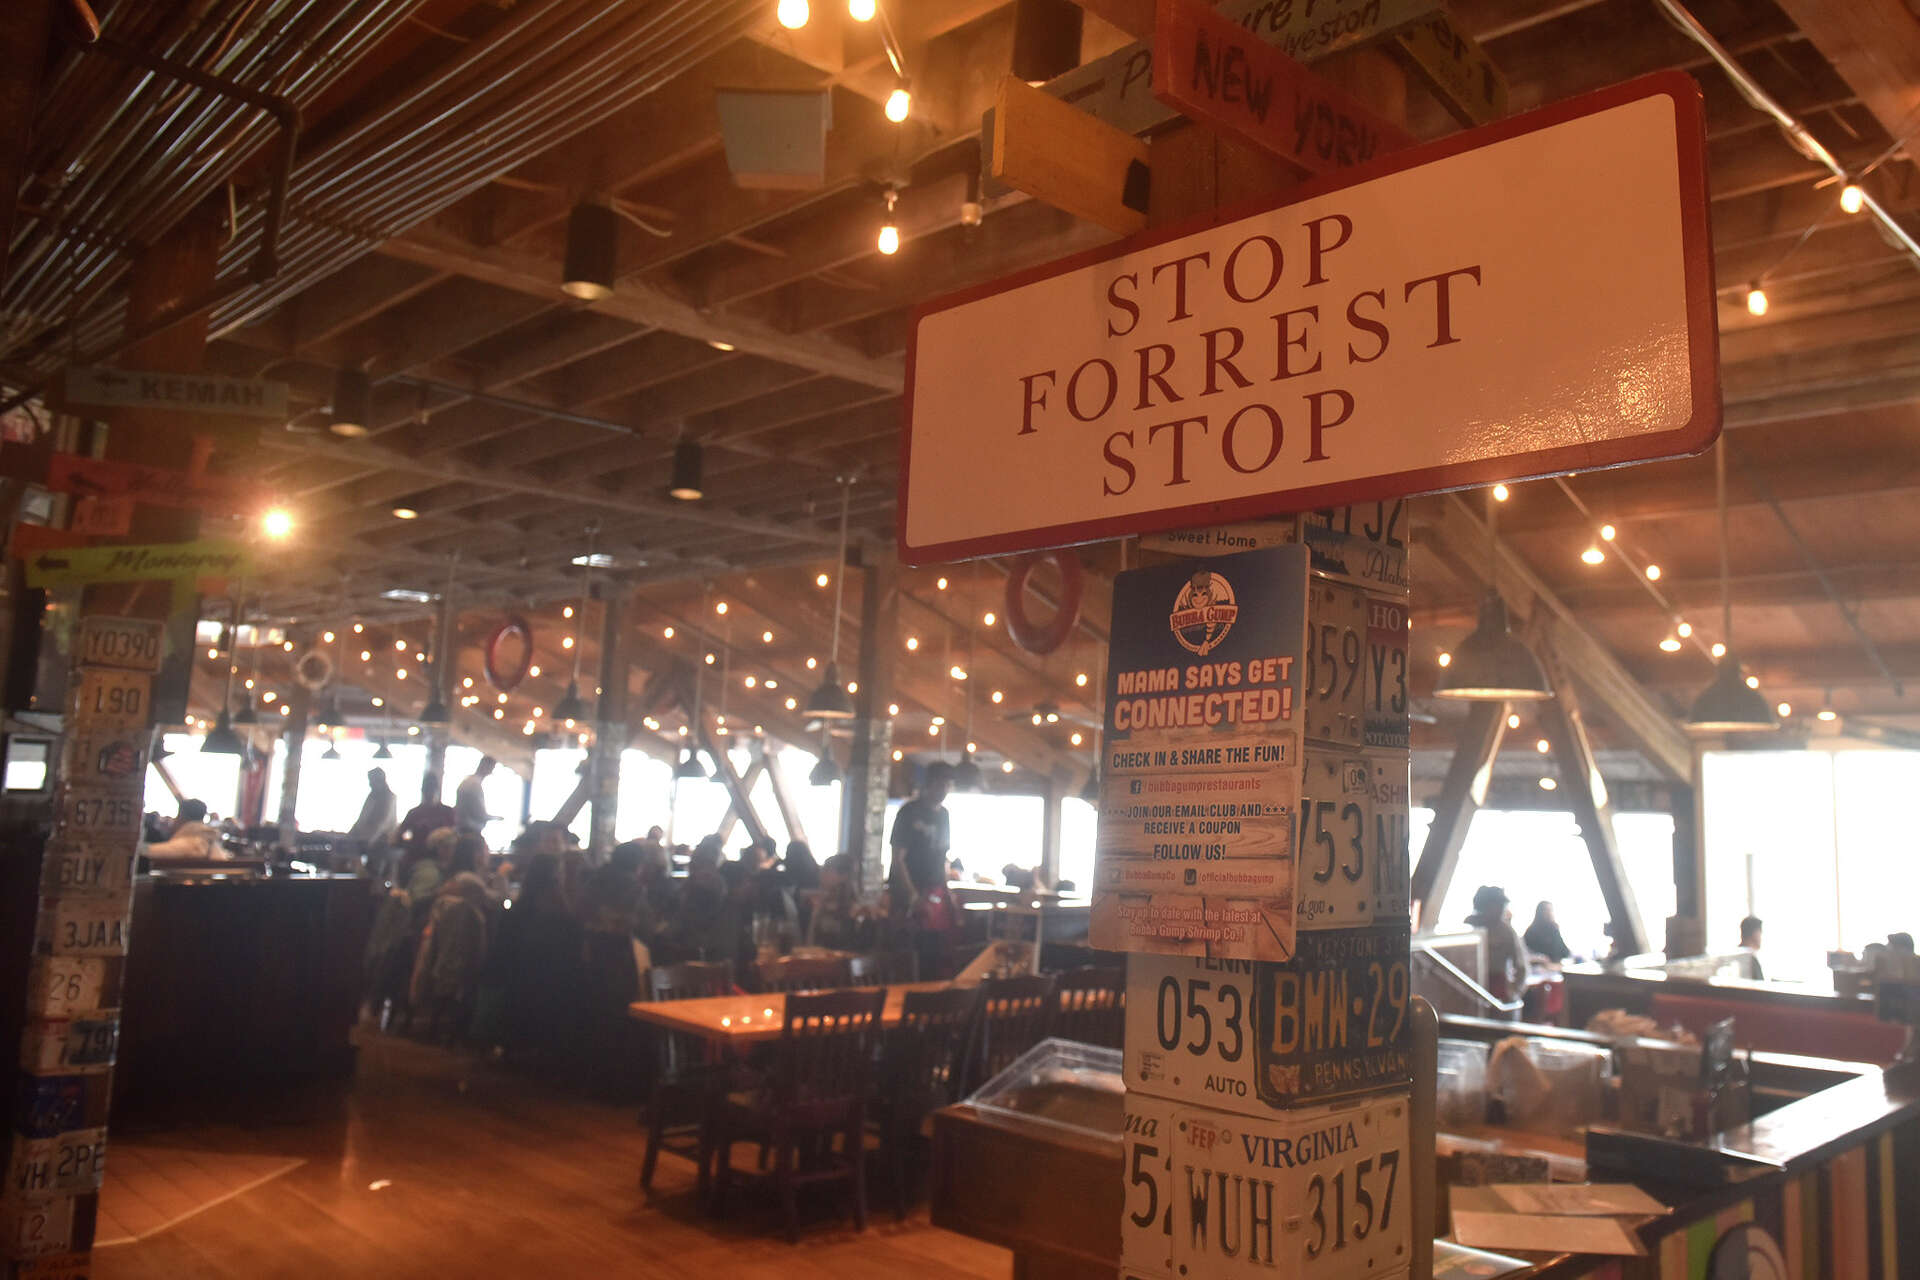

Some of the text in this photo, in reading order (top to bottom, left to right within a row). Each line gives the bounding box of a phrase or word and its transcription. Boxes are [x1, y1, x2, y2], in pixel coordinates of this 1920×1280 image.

[1192, 28, 1376, 167] NEW YORK
[1106, 213, 1354, 340] STOP
[1017, 264, 1482, 437] FORREST
[141, 377, 264, 406] KEMAH
[1102, 388, 1356, 497] STOP
[1167, 530, 1257, 548] Sweet Home
[1117, 656, 1293, 695] MAMA SAYS GET
[1113, 687, 1293, 732] CONNECTED!
[1112, 745, 1286, 769] CHECK IN & SHARE THE FUN!
[1127, 804, 1262, 819] JOIN OUR EMAIL CLUB AND
[1144, 821, 1241, 835] RECEIVE A COUPON
[1153, 844, 1227, 861] FOLLOW US!
[1183, 907, 1202, 920] with
[1204, 908, 1220, 921] the
[1222, 909, 1249, 922] latest
[1251, 910, 1262, 922] at
[1159, 924, 1185, 939] Gump
[1187, 926, 1221, 941] Shrimp
[1204, 1074, 1248, 1097] AUTO
[1241, 1120, 1359, 1170] VIRGINIA
